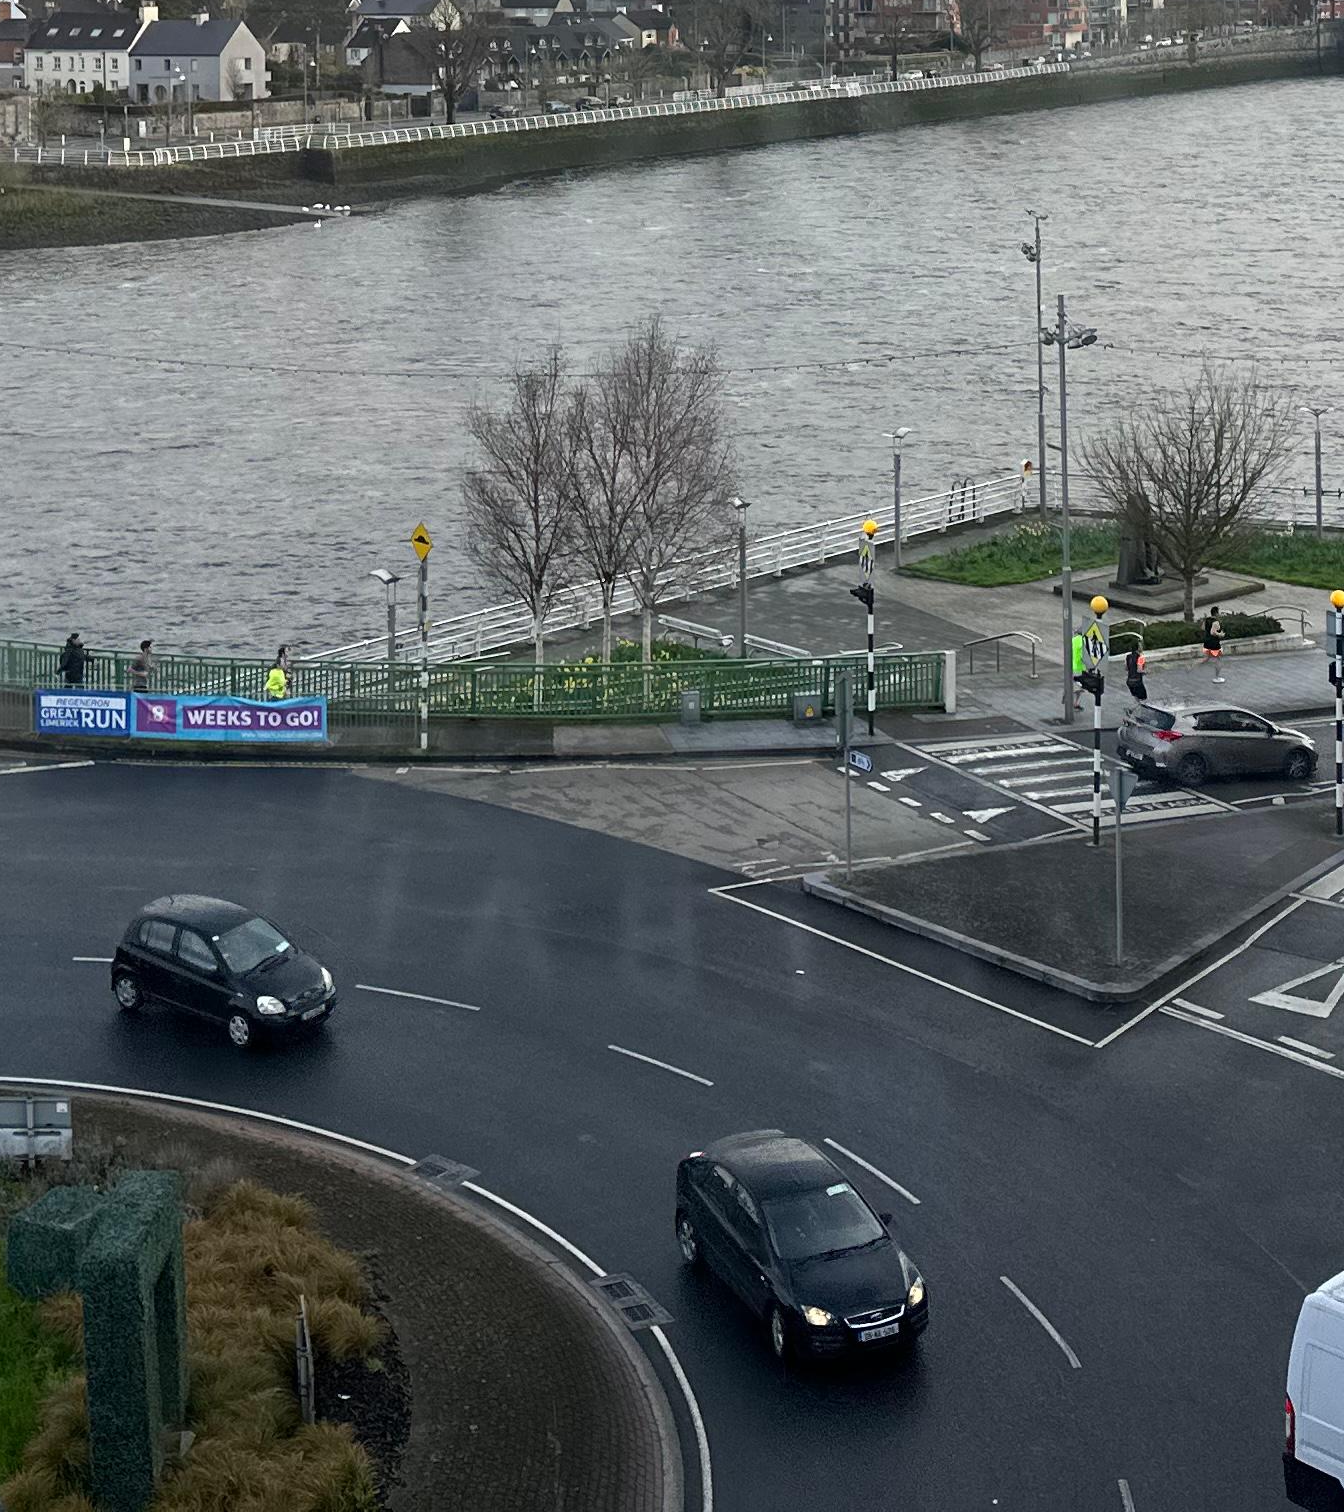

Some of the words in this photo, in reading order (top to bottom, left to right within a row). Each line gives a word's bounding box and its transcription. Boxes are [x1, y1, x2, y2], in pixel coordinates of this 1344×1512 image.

[56, 697, 110, 707] REGENERON
[40, 707, 79, 719] GREAT
[80, 709, 126, 729] RUN
[186, 709, 252, 726] WEEKS
[256, 711, 282, 727] TO
[286, 710, 319, 727] GO!
[40, 718, 79, 727] LIMERICK
